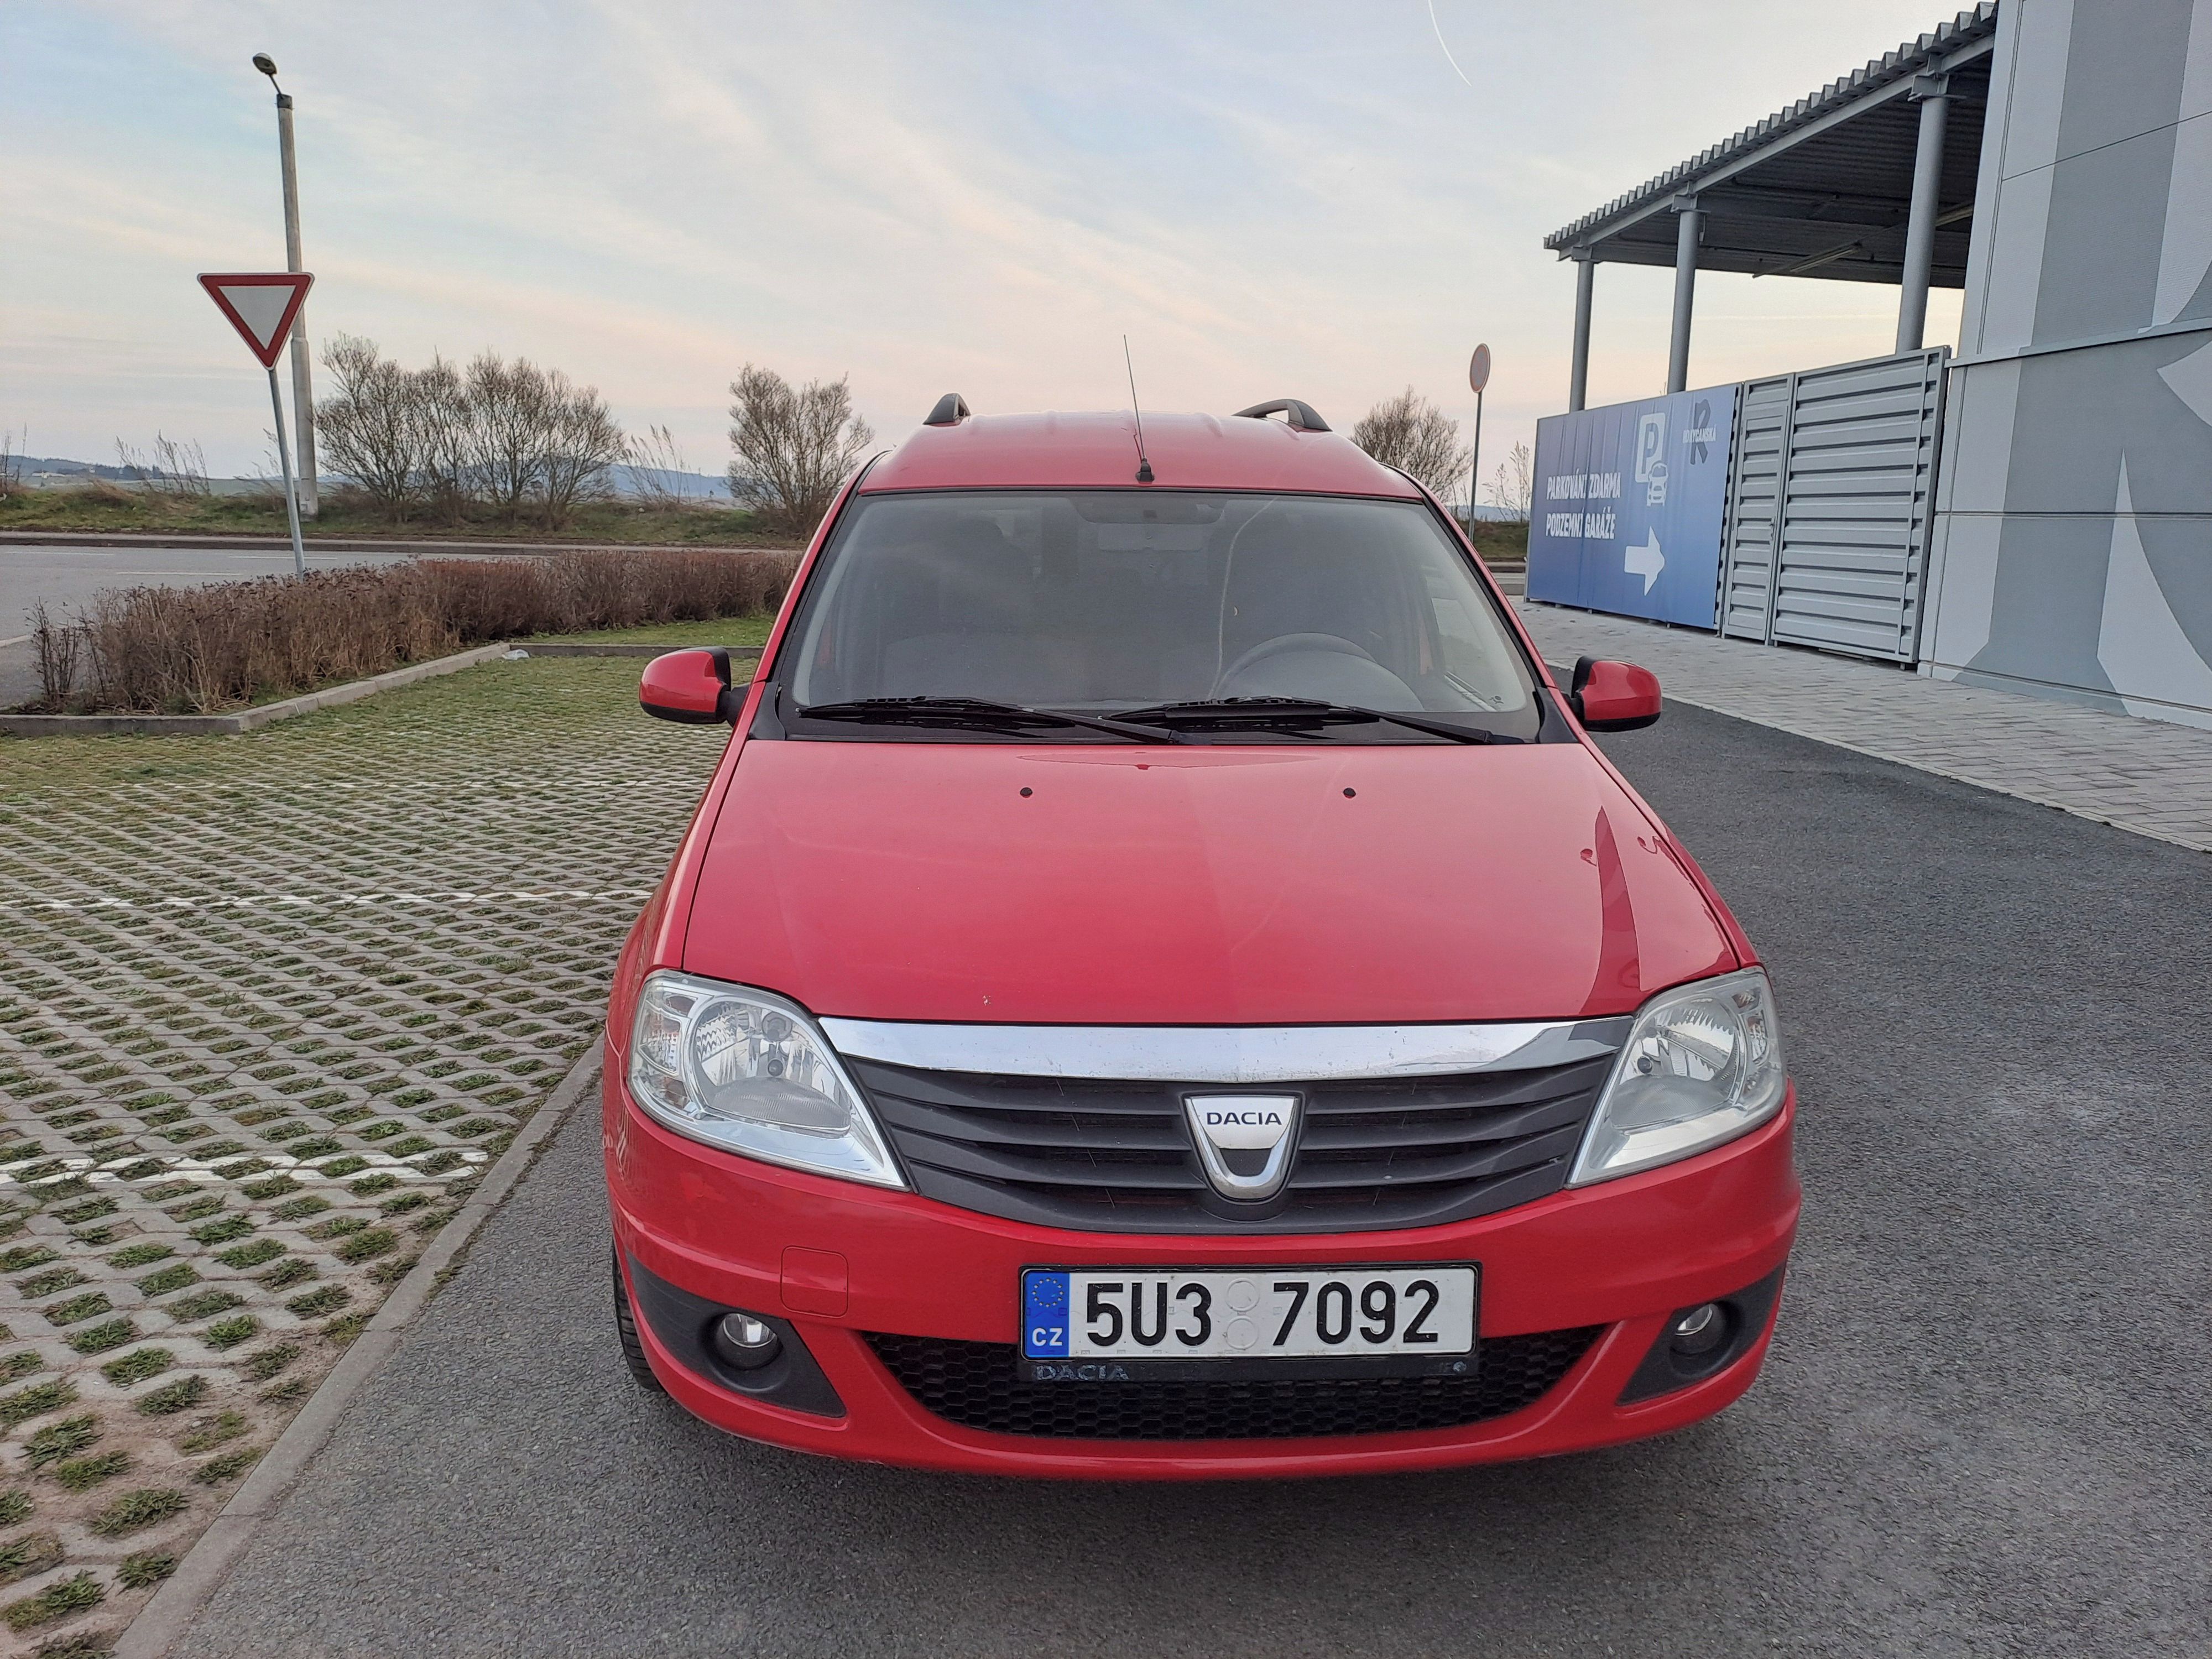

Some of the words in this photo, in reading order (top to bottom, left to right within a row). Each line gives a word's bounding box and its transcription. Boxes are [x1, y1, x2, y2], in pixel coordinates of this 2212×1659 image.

[1641, 422, 1659, 474] P
[1547, 468, 1588, 500] PARKOVÁNÍ
[1589, 472, 1621, 499] ZDARMA
[1546, 507, 1584, 537] PODZEMNÍ
[1585, 507, 1616, 539] GARÁŽE
[1207, 1112, 1282, 1125] DACIA
[1086, 1282, 1212, 1346] 5U3
[1272, 1281, 1439, 1346] 7092
[1032, 1328, 1063, 1347] CZ
[1036, 1364, 1129, 1380] DACIA
